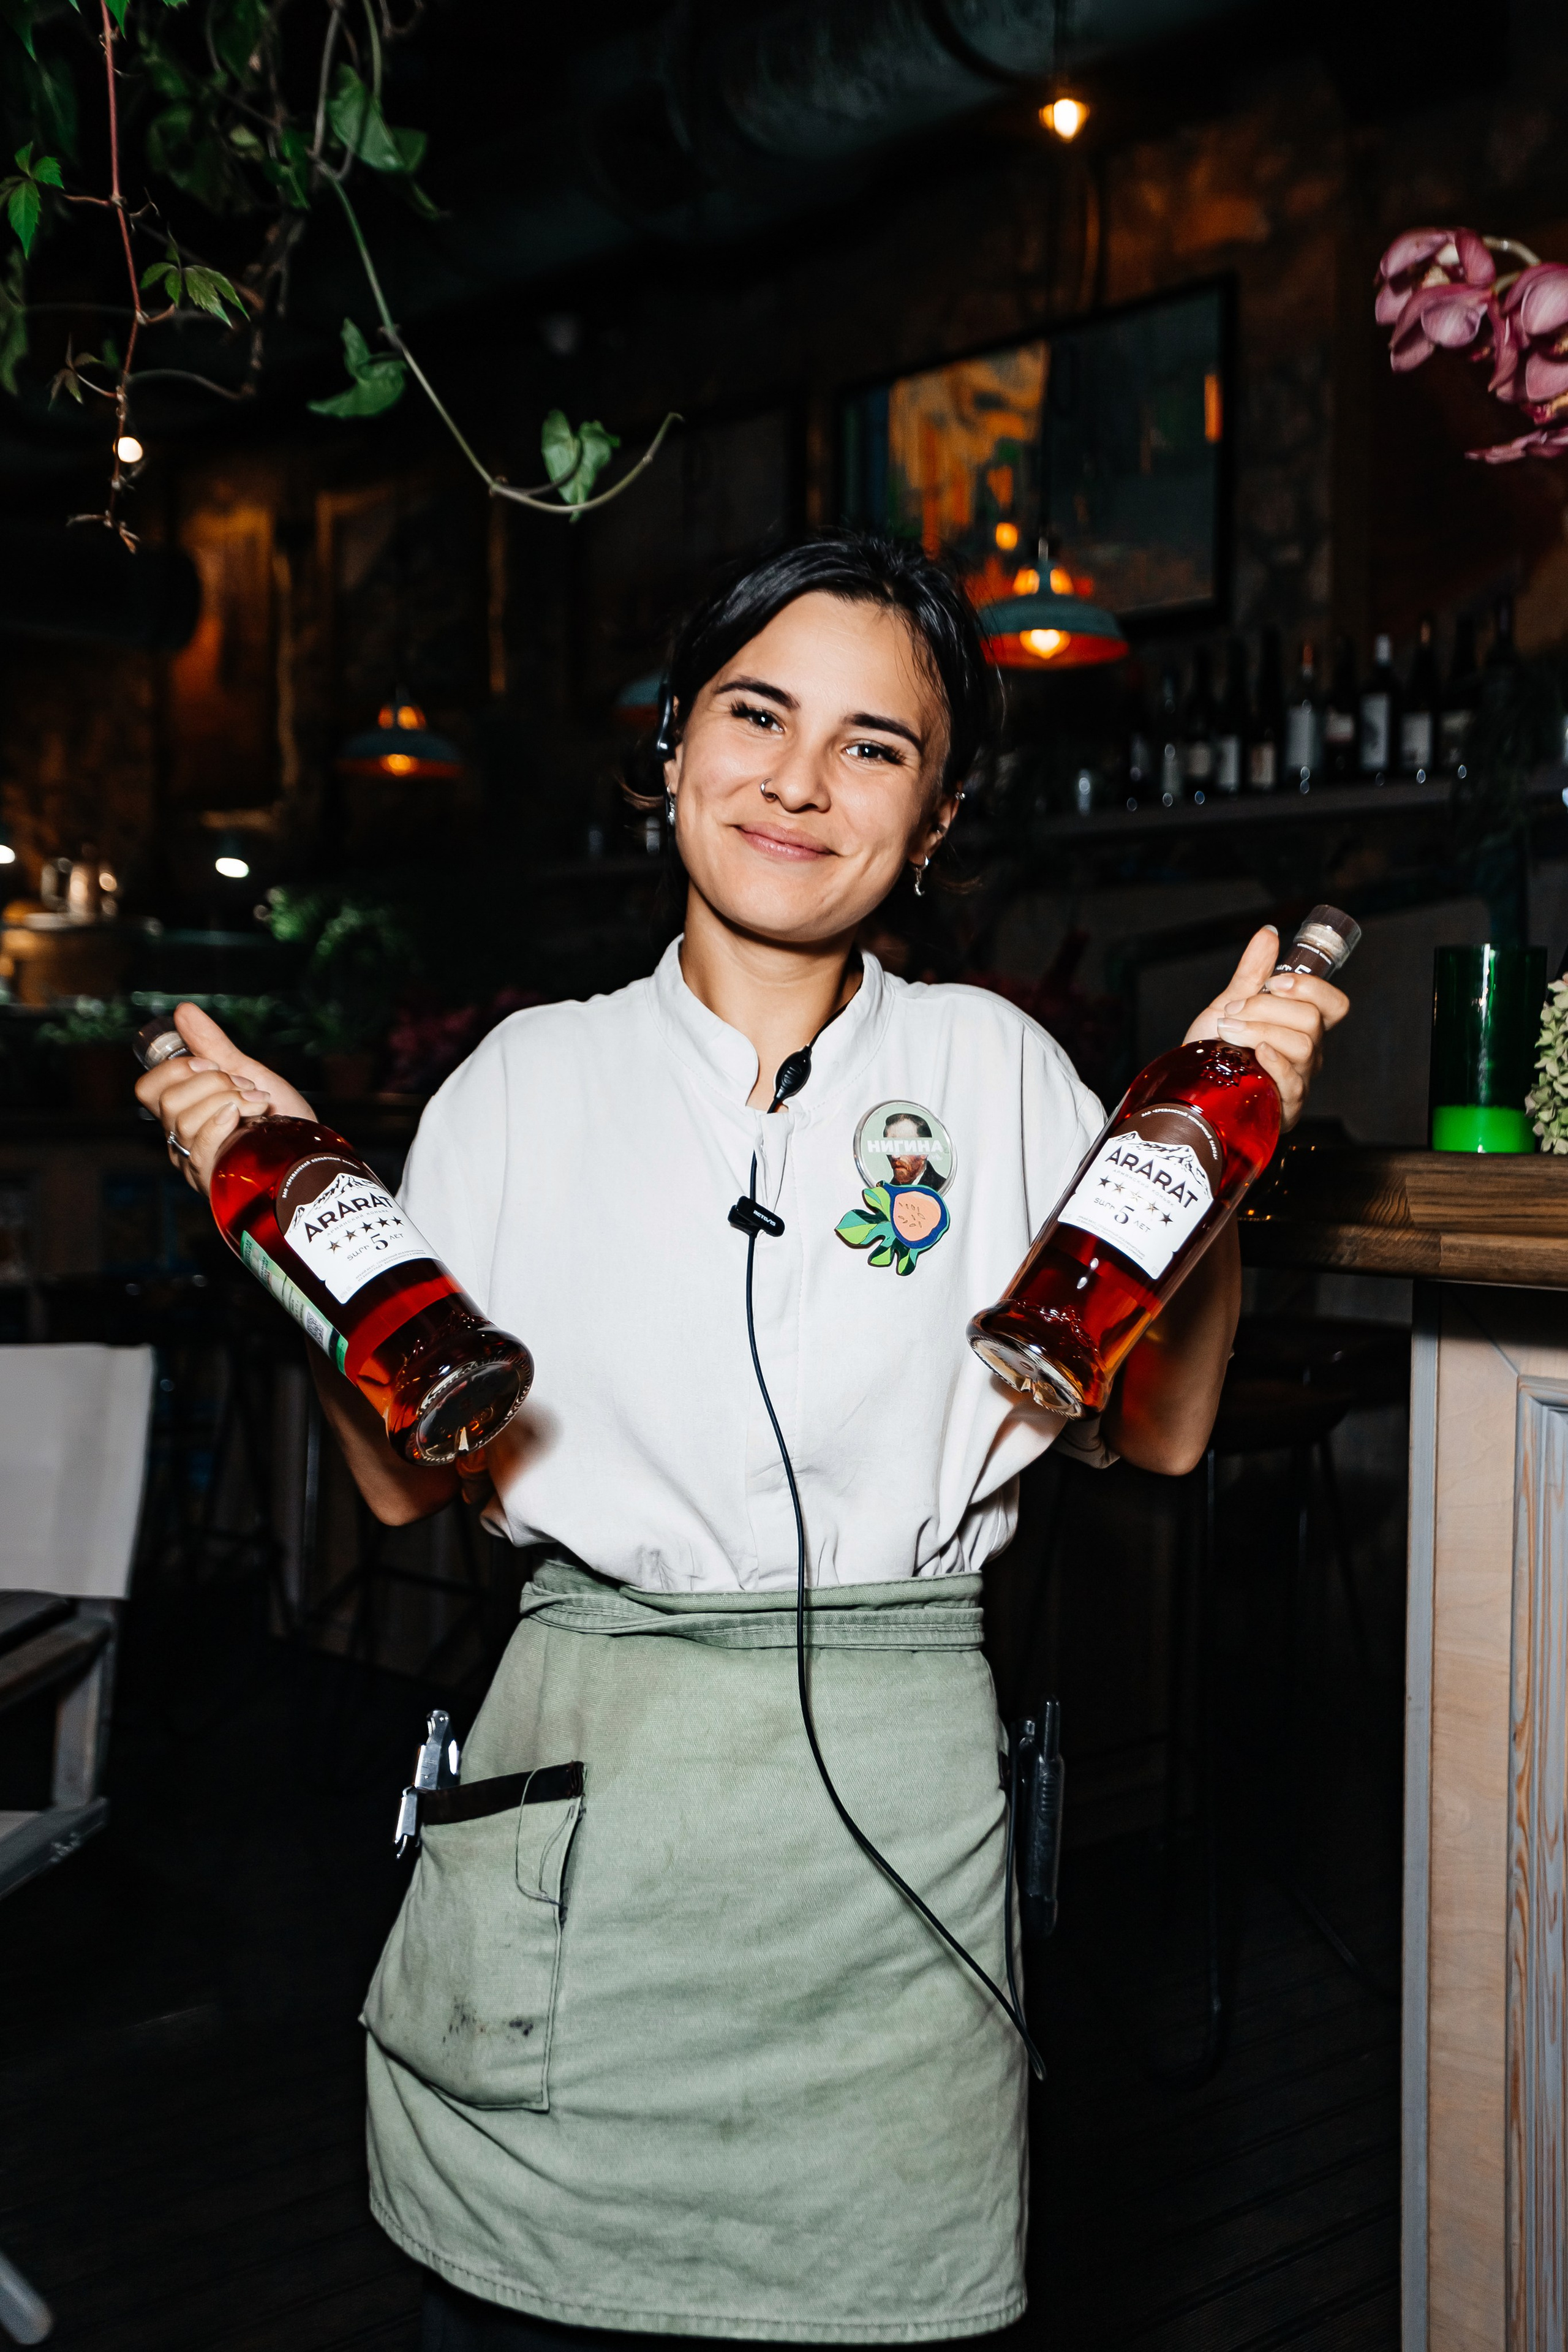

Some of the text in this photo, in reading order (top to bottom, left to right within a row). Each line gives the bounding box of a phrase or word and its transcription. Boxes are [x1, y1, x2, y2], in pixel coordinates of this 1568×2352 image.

[867, 1140, 943, 1153] НИГИНА
[1104, 1145, 1199, 1208] ARARAT
[304, 1192, 393, 1243] ARARAT
[1114, 1205, 1135, 1224] 5
[1133, 1220, 1151, 1233] ЛЕТ
[371, 1233, 388, 1250] 5
